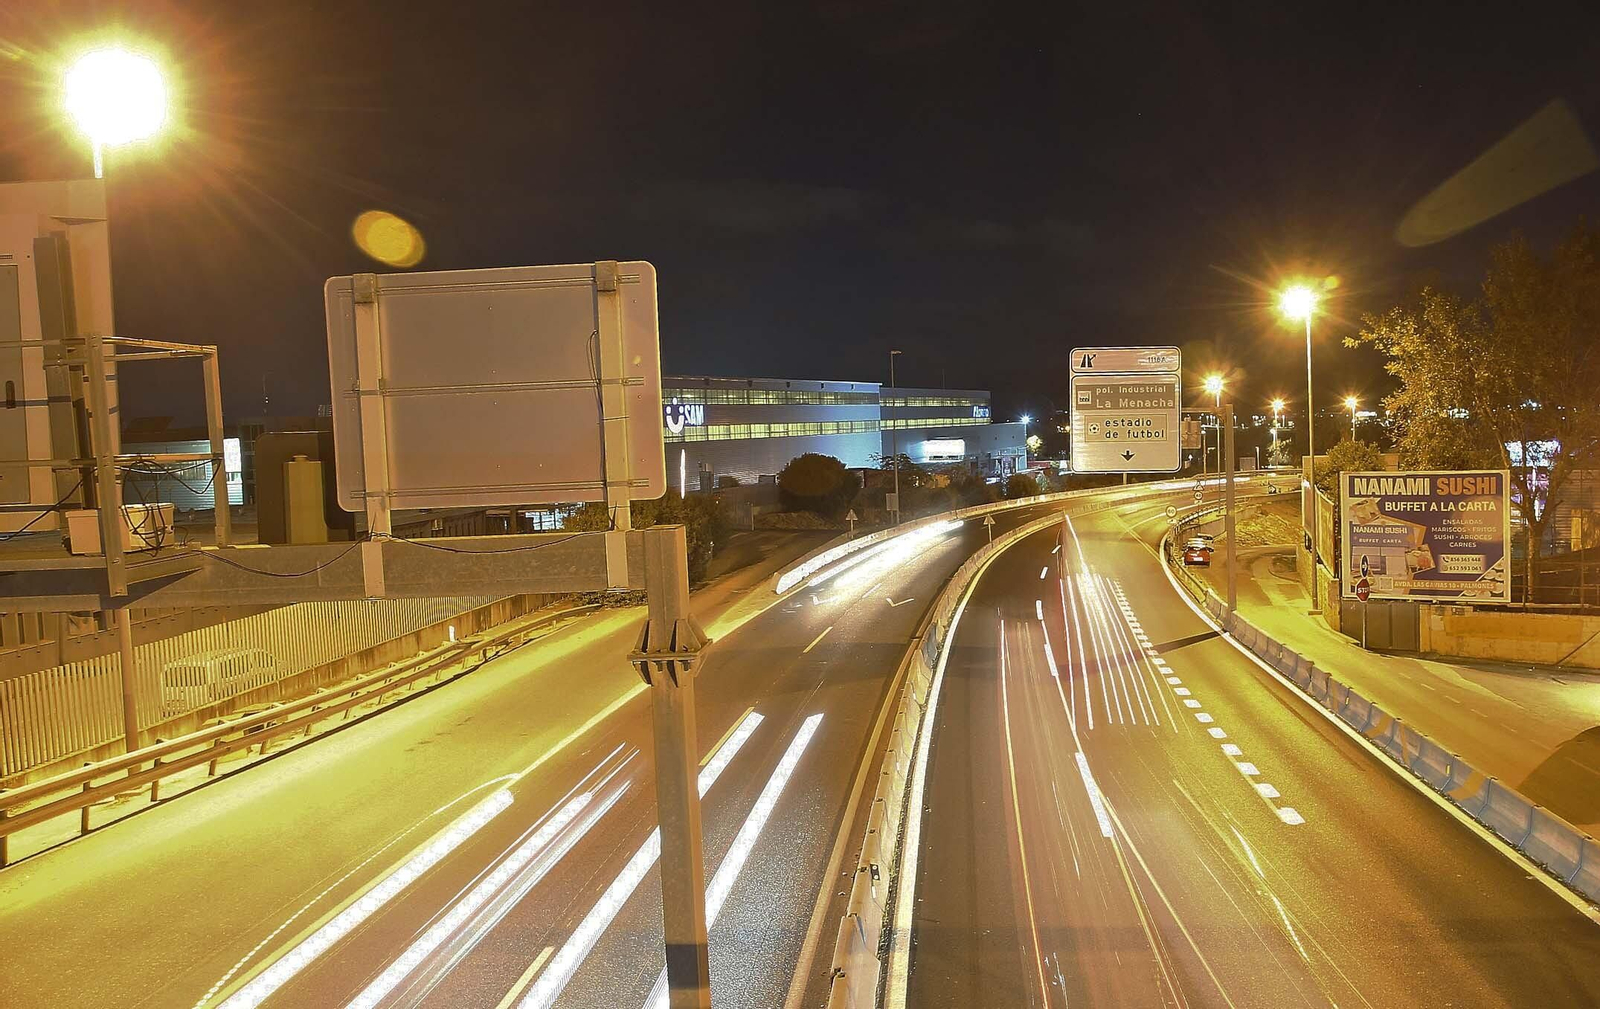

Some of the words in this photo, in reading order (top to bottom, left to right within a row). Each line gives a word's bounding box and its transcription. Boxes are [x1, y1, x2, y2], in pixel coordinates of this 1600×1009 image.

[1096, 388, 1114, 396] pol.
[1096, 400, 1112, 408] La
[1119, 398, 1174, 408] Menacha
[1105, 418, 1152, 427] estadio
[1105, 430, 1118, 439] de
[1127, 429, 1164, 438] futbol
[1354, 478, 1430, 496] NANAMI
[1436, 476, 1496, 496] SUSHI
[1385, 501, 1427, 512] BUFFET
[1430, 502, 1439, 512] A
[1441, 501, 1456, 512] LA
[1458, 500, 1496, 512] CARTA
